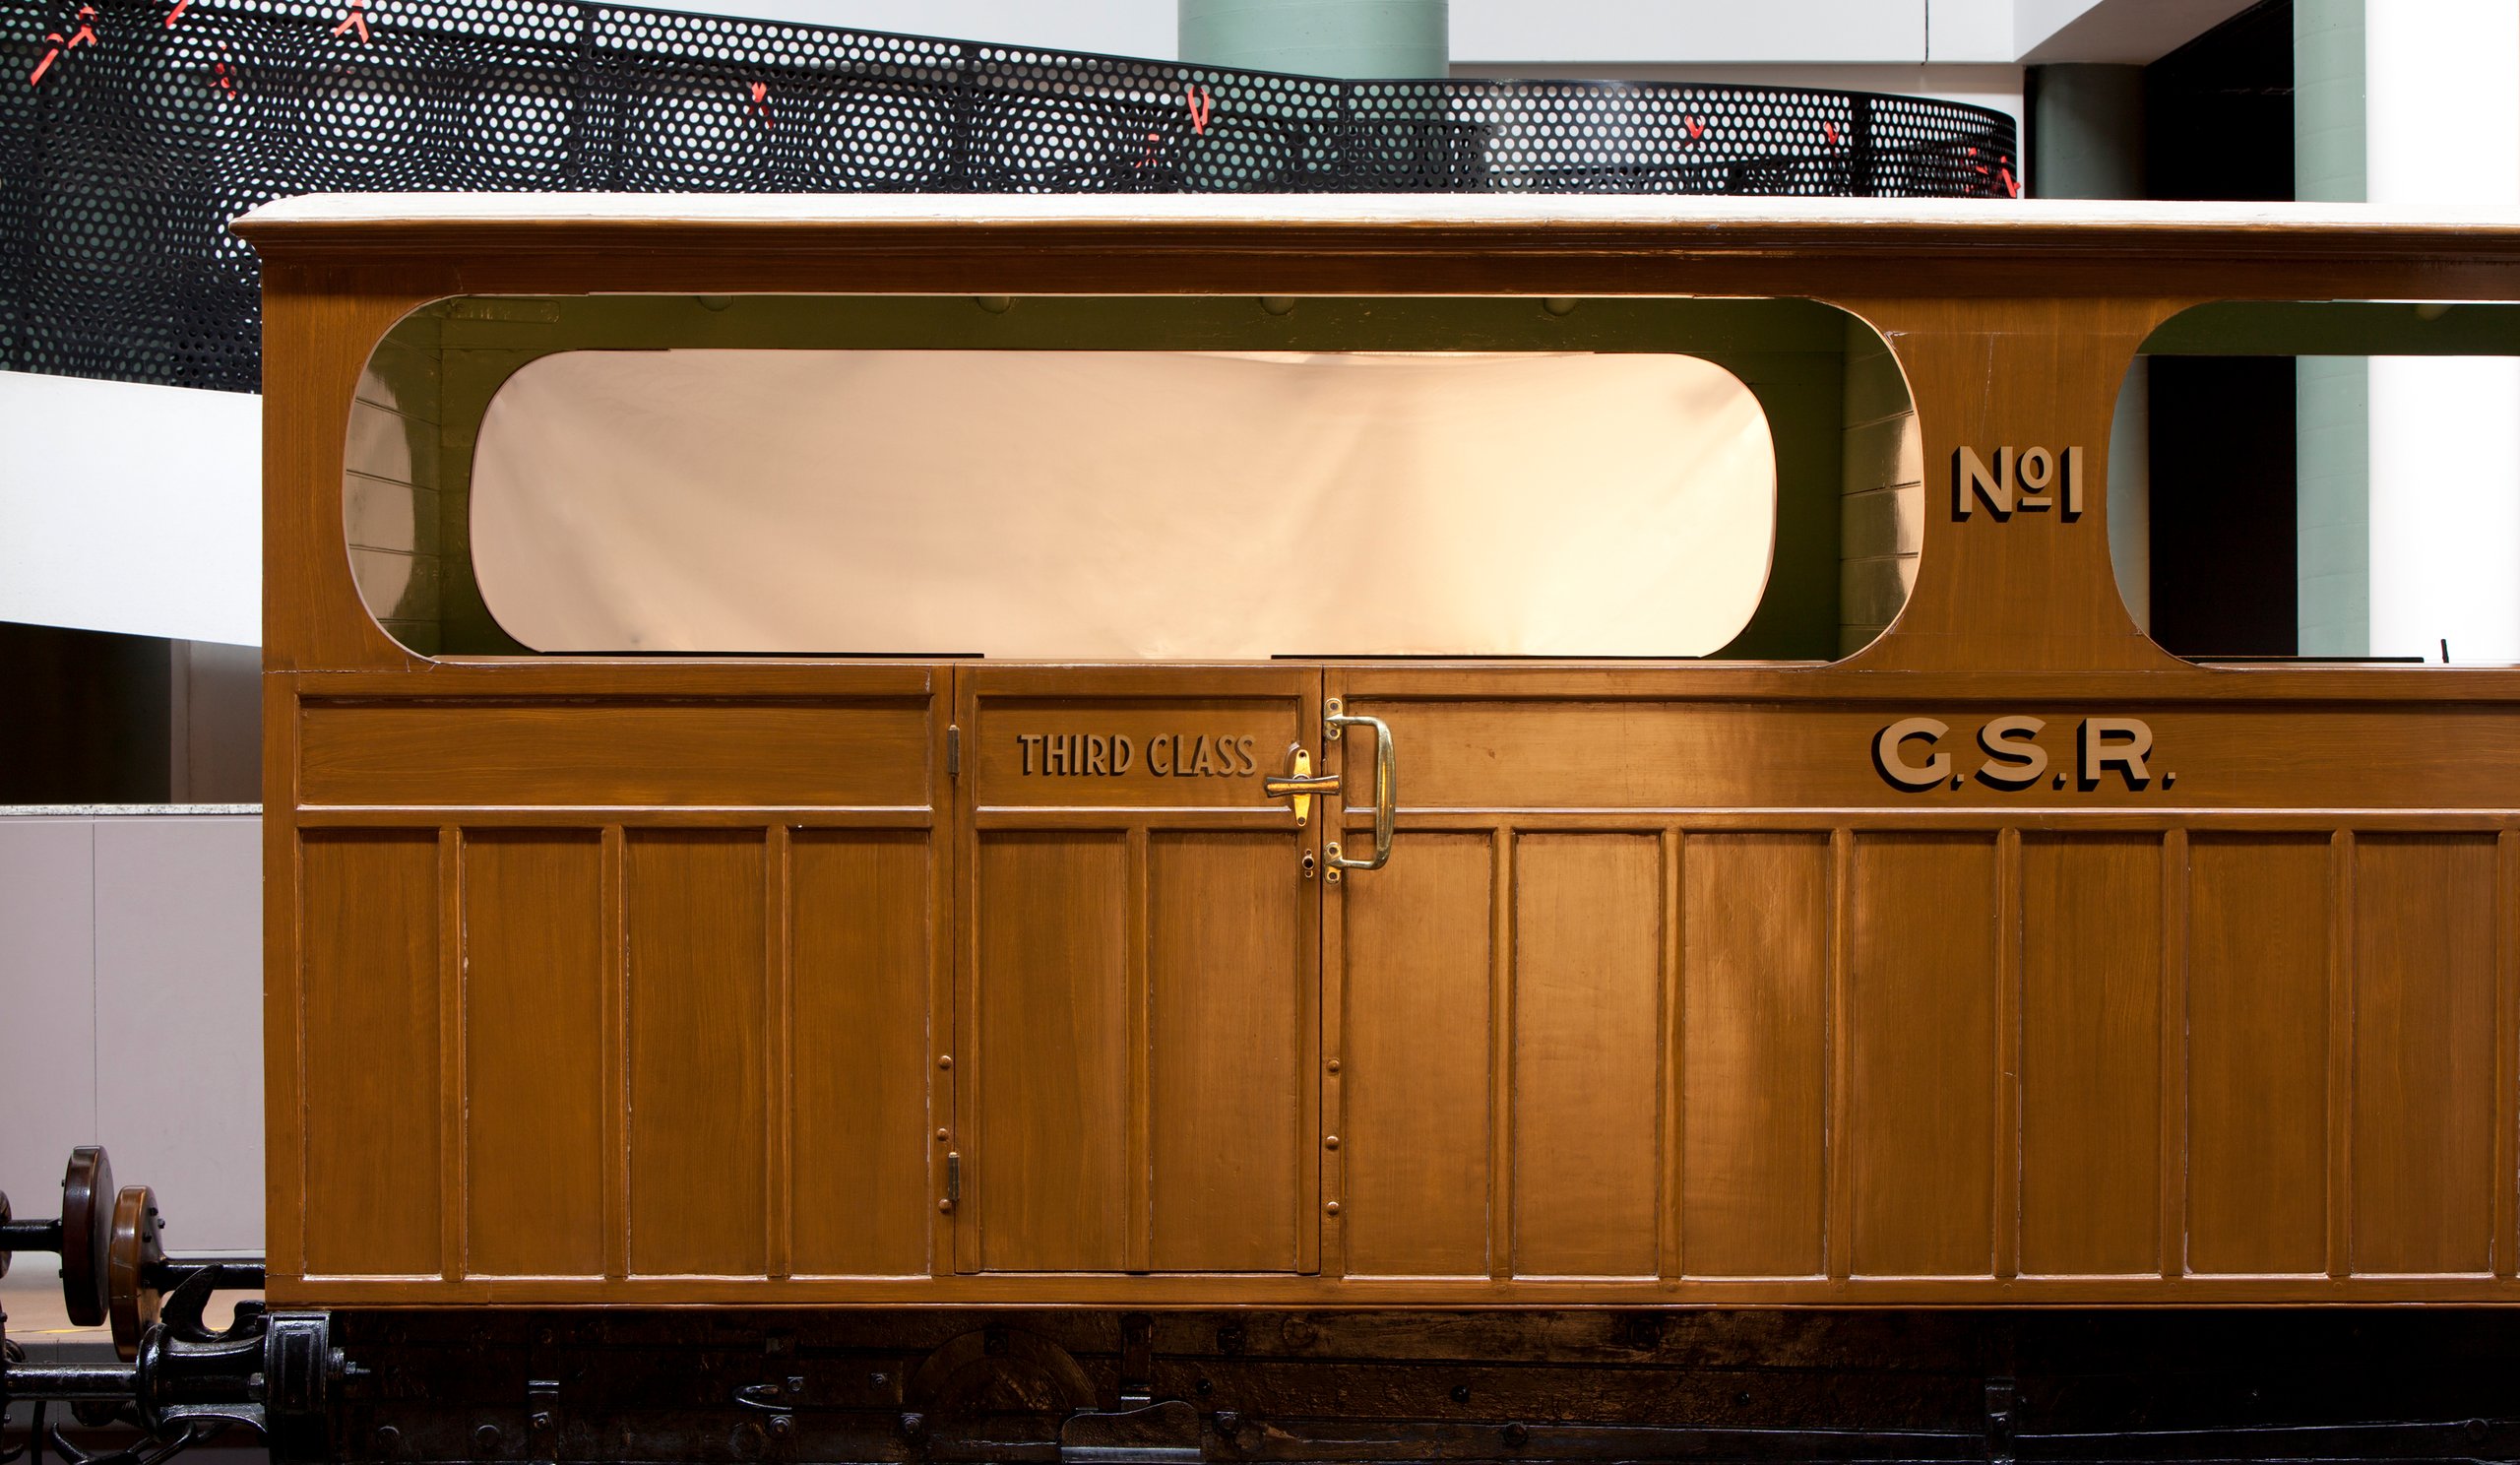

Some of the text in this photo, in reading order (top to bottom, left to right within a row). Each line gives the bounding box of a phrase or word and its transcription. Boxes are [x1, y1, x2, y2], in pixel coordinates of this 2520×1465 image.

[1017, 732, 1258, 777] THIRD CLASS
[1871, 715, 2176, 794] G.S.R.
